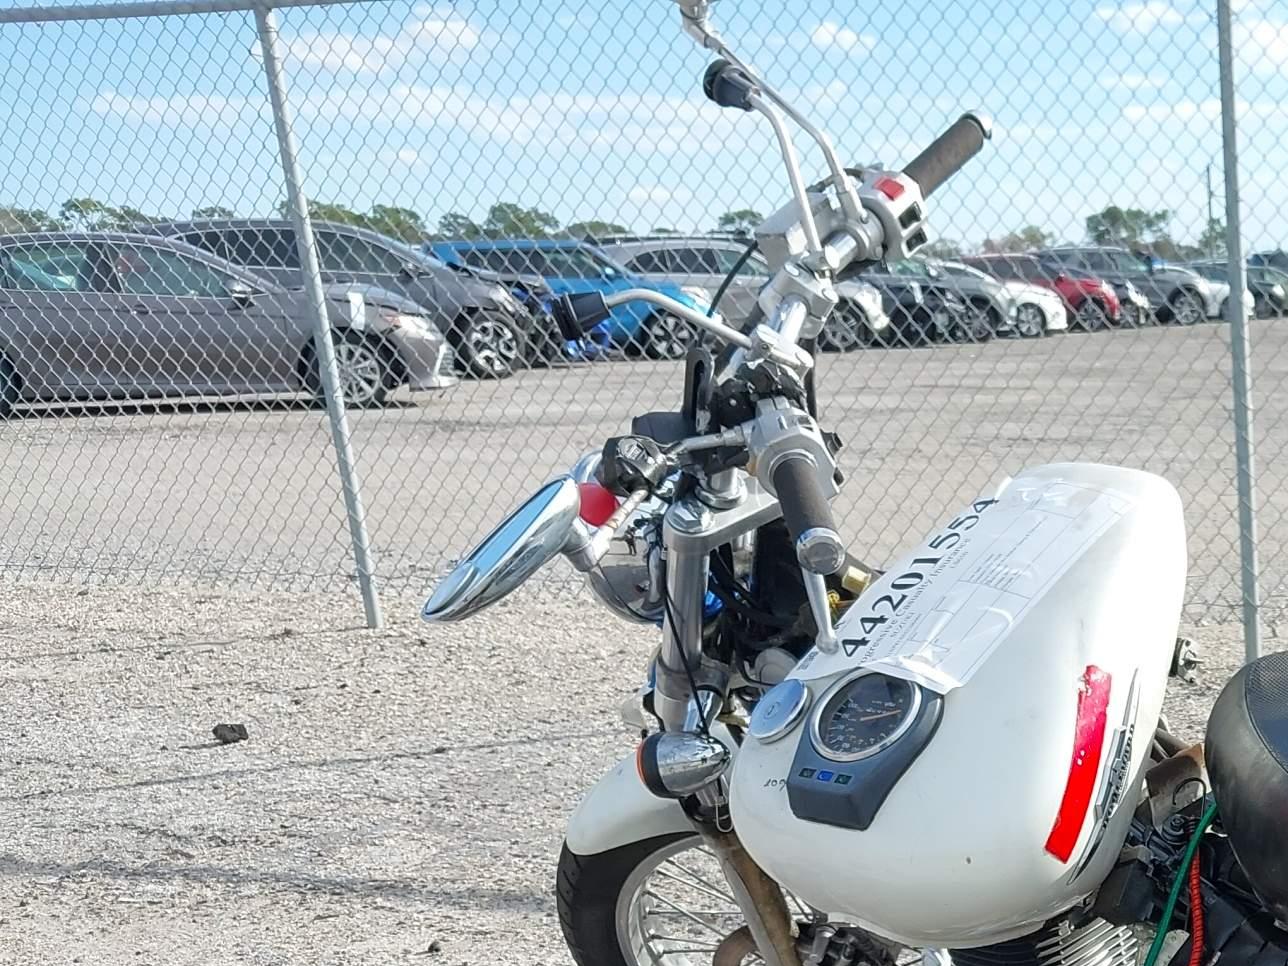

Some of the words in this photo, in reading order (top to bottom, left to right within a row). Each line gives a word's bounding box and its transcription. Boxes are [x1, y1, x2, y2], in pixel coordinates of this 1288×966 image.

[842, 497, 1000, 658] 44201554
[857, 619, 898, 665] ogressive
[895, 578, 933, 618] Casualty
[929, 538, 971, 577] Insurance
